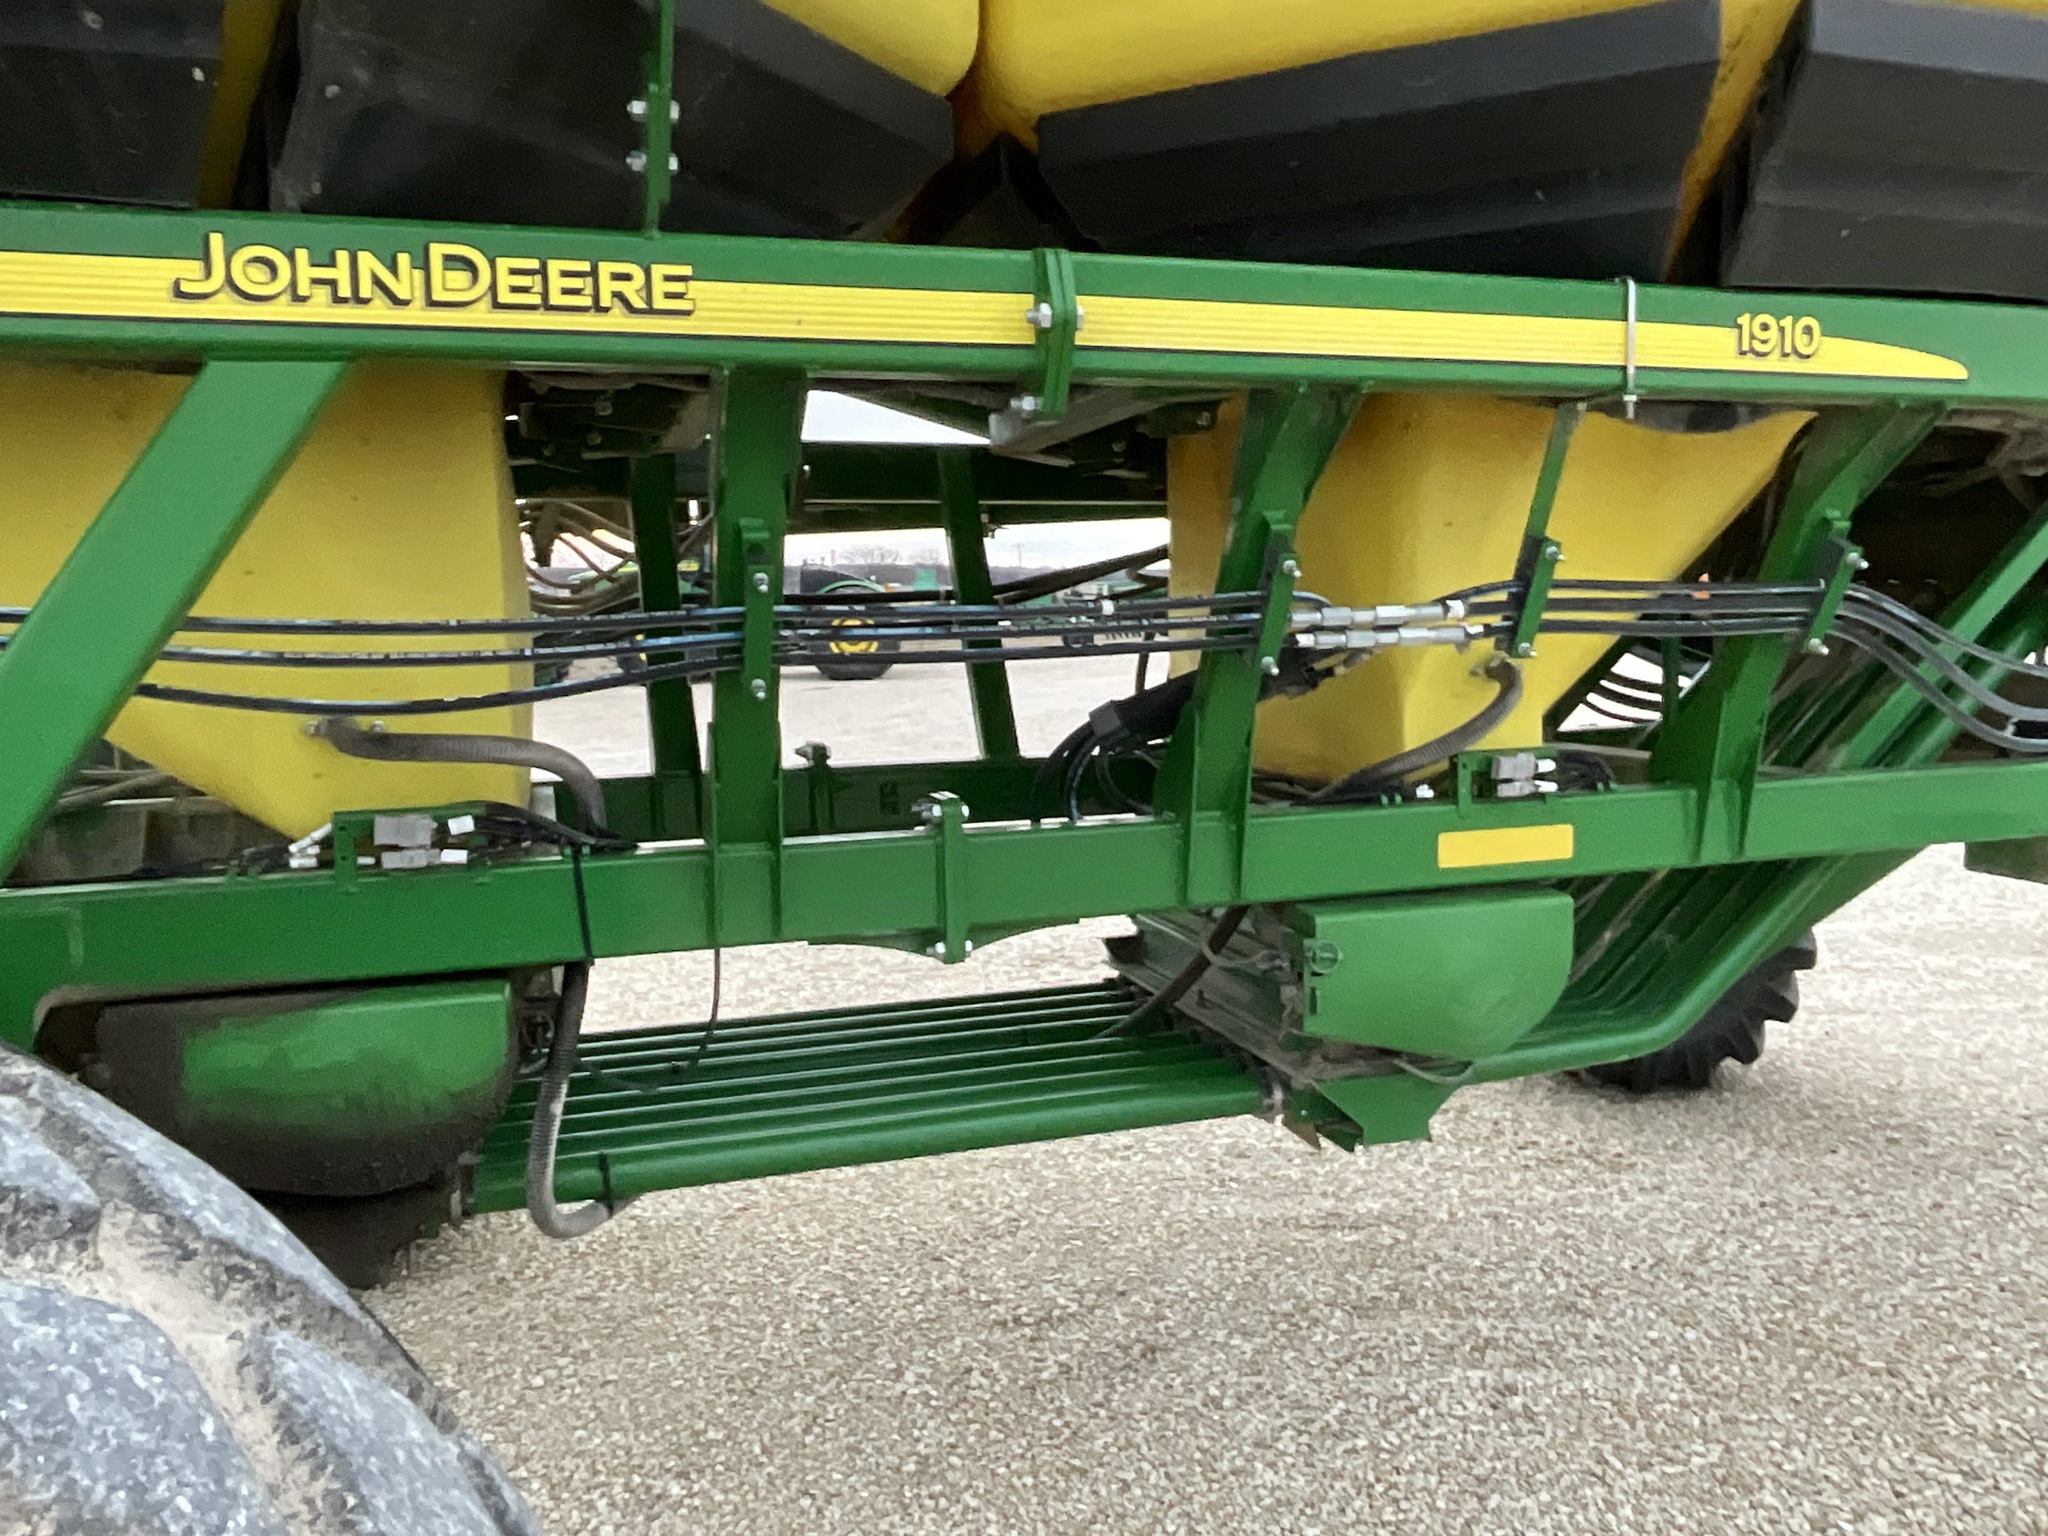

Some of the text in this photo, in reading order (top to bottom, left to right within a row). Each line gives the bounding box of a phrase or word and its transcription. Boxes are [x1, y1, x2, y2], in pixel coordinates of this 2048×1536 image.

[174, 231, 695, 316] JOHN DEERE
[1736, 312, 1821, 359] 1910
